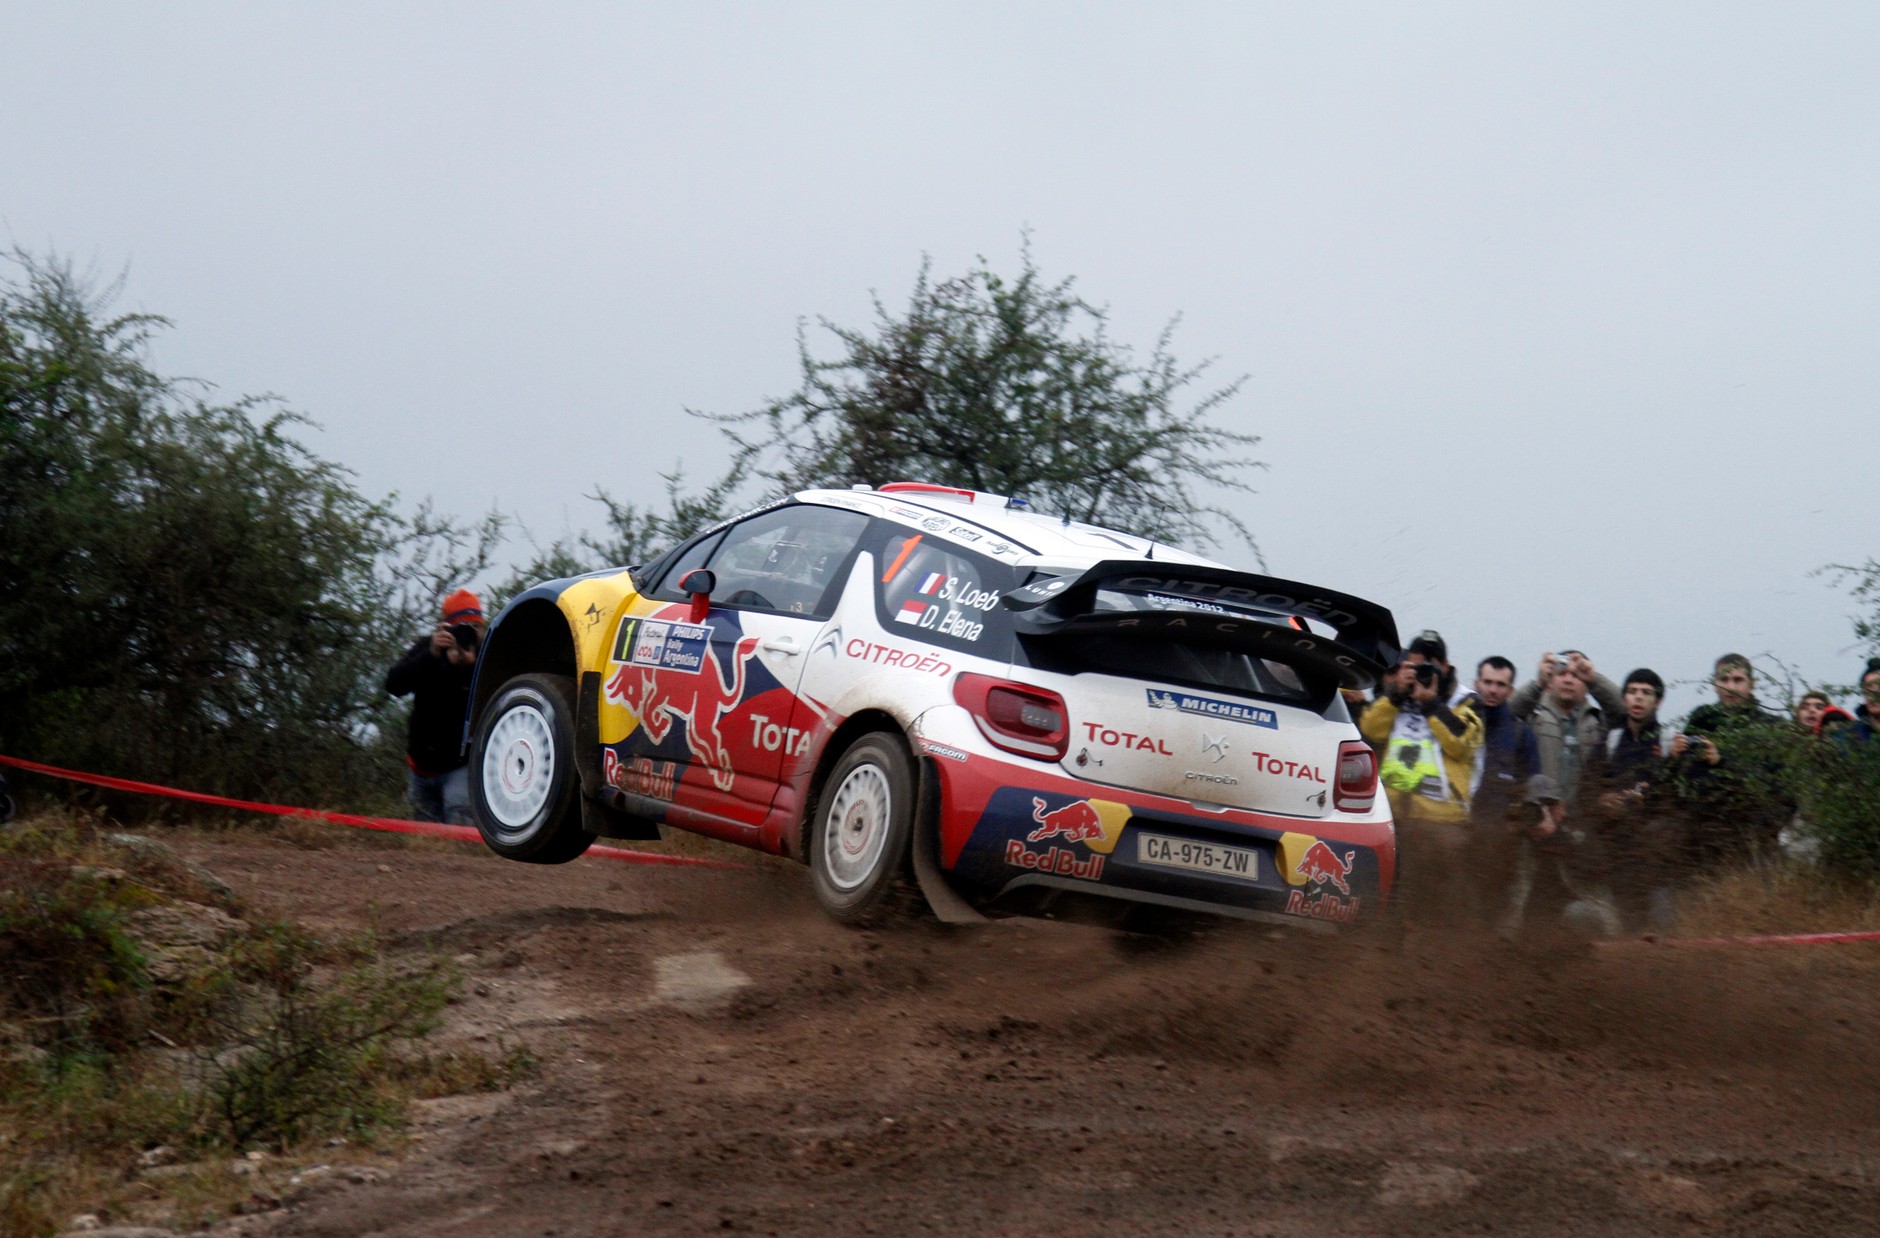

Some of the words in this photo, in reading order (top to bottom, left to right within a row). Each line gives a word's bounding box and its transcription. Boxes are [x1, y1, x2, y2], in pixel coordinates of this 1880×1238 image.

[881, 534, 923, 583] 1
[938, 576, 959, 600] S.
[956, 581, 1000, 611] Loeb
[1196, 601, 1224, 614] 2012
[621, 620, 636, 659] 1
[672, 625, 705, 640] PHILIPS
[919, 604, 940, 630] D.
[937, 609, 984, 642] Elena
[662, 649, 700, 667] Argentina
[1181, 698, 1272, 723] MICHELIN
[749, 713, 815, 757] TOTA
[1082, 721, 1173, 756] TOTAL
[1252, 751, 1326, 783] TOTAL
[1147, 838, 1250, 873] CA-975-ZW
